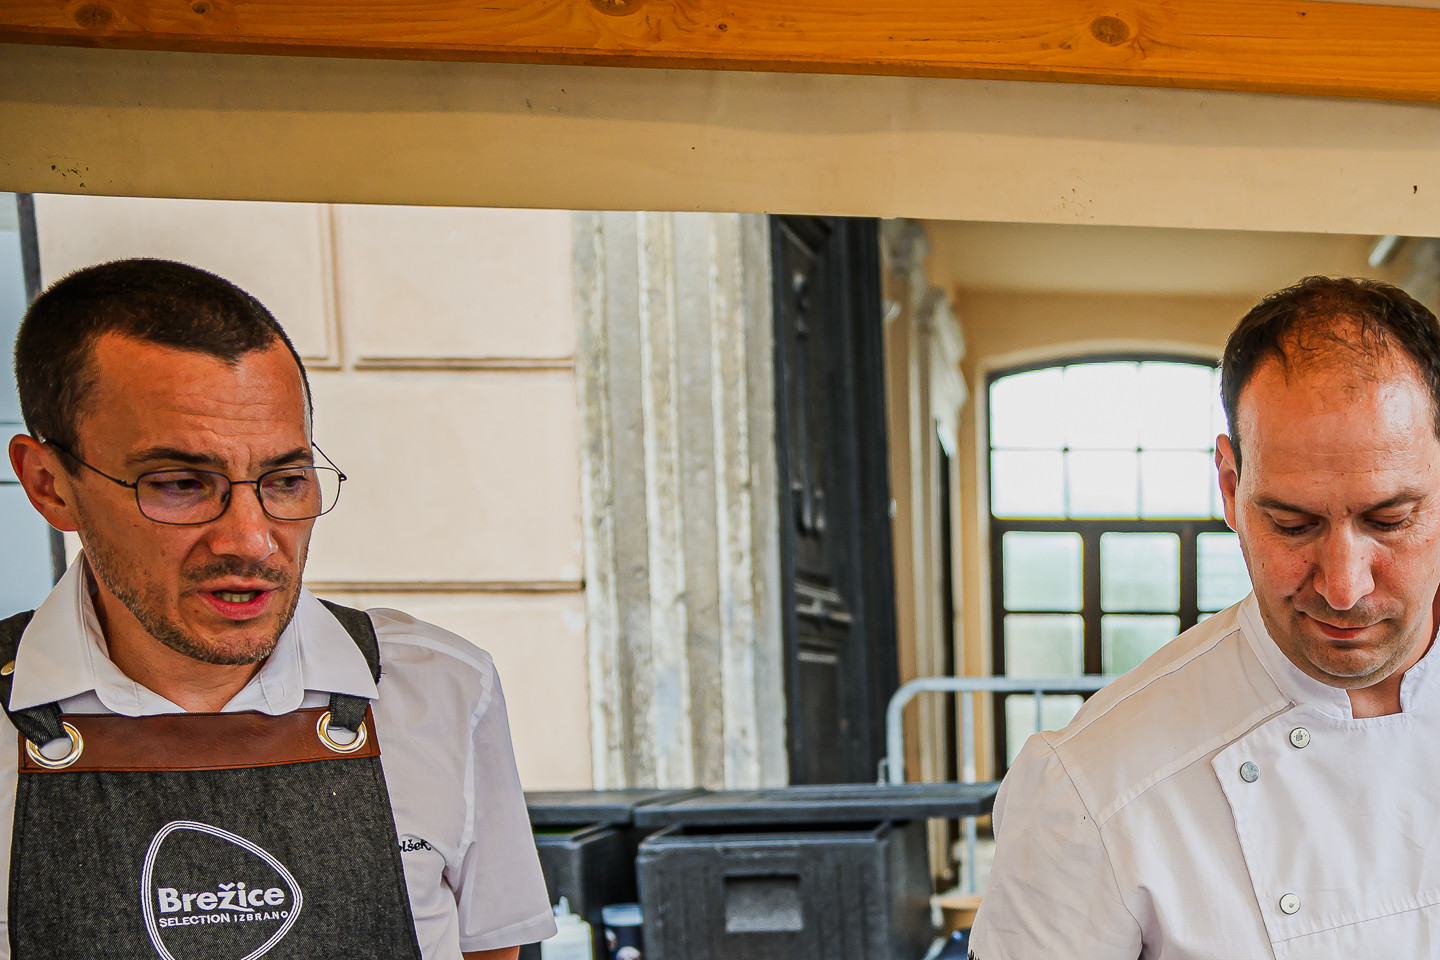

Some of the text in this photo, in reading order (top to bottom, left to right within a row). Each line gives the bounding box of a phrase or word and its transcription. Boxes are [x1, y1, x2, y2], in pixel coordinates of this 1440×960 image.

[399, 838, 432, 852] lšek
[158, 881, 285, 913] Brežice
[159, 910, 289, 928] SELECTION IZBRANO
